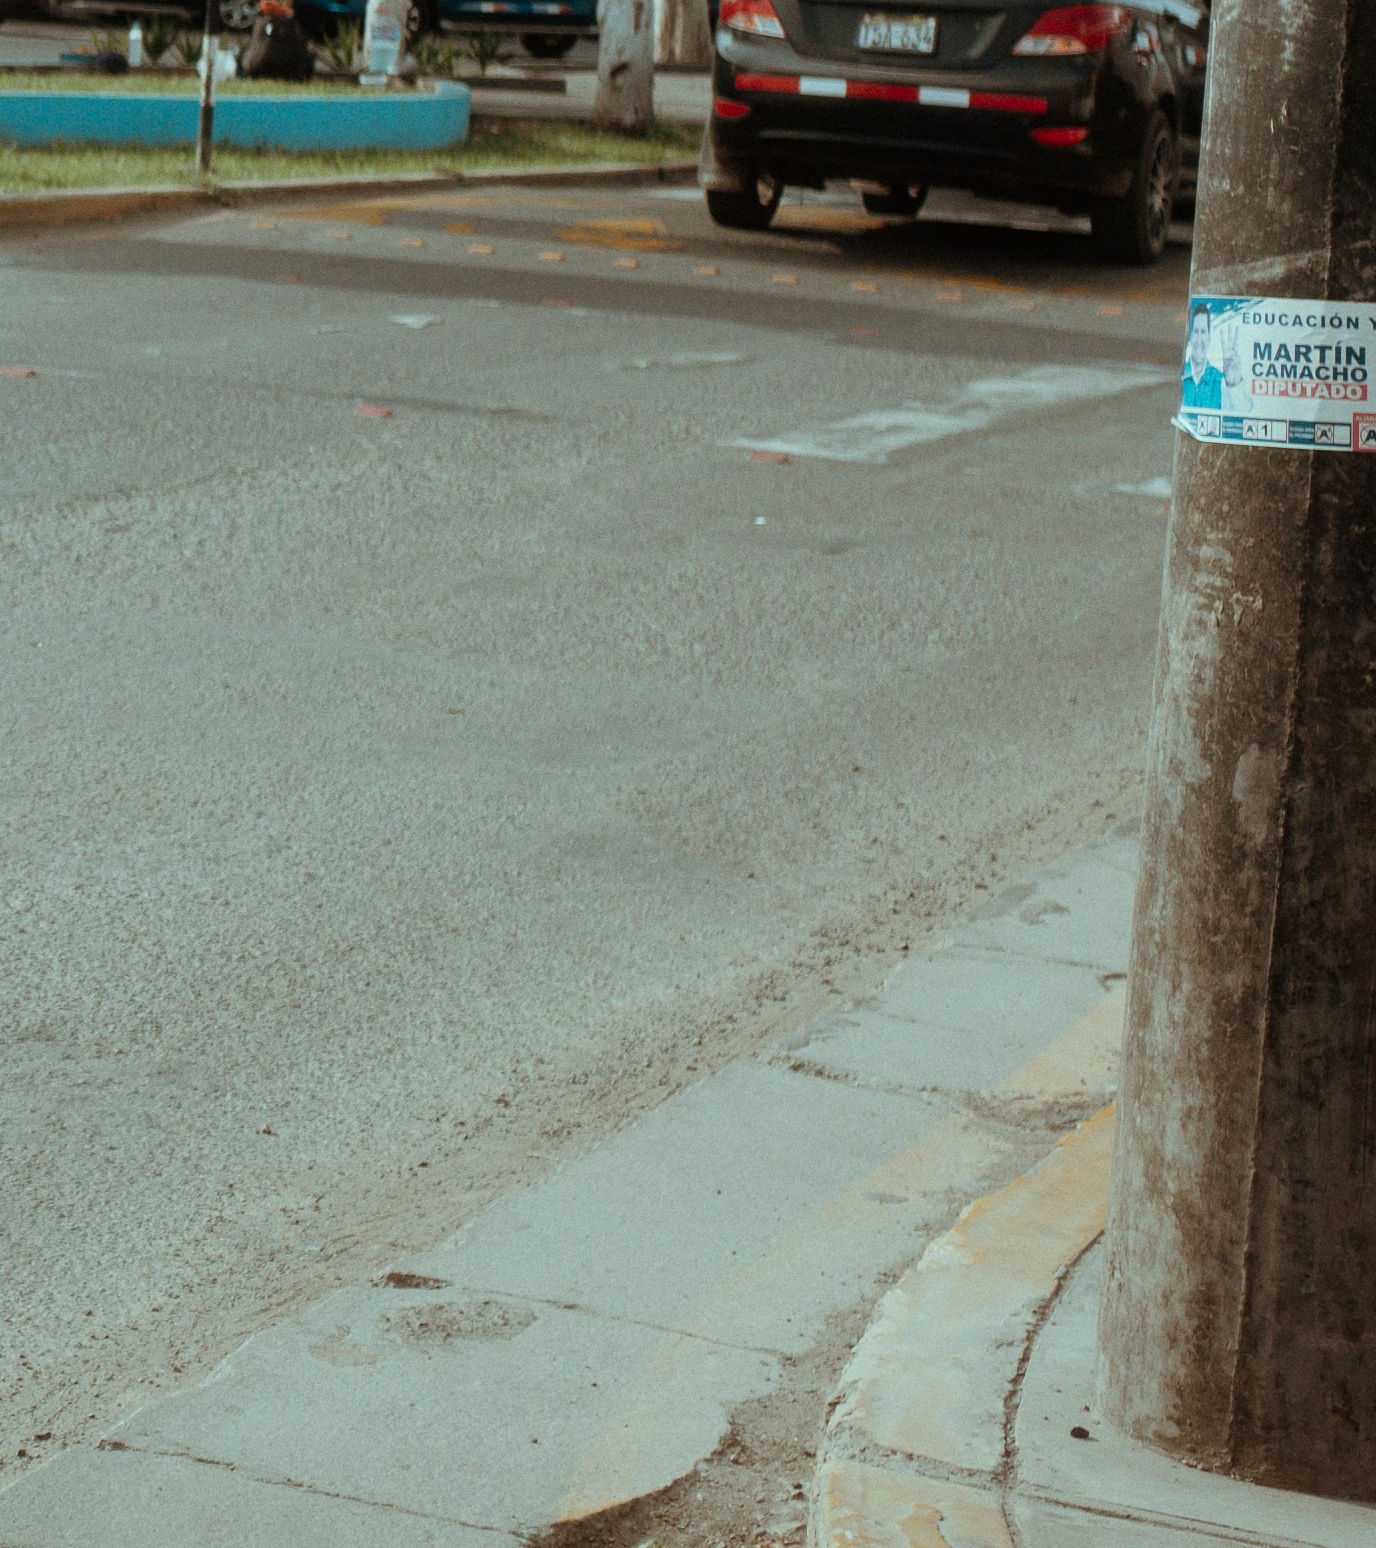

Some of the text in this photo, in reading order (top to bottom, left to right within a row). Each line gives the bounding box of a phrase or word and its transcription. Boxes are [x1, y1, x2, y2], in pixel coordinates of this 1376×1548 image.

[1242, 311, 1360, 330] EDUCACIÓN
[1252, 340, 1367, 366] MARTÍN
[1251, 362, 1368, 383] CAMACHO
[1254, 380, 1363, 400] DIPUTADO
[1261, 423, 1269, 438] 1
